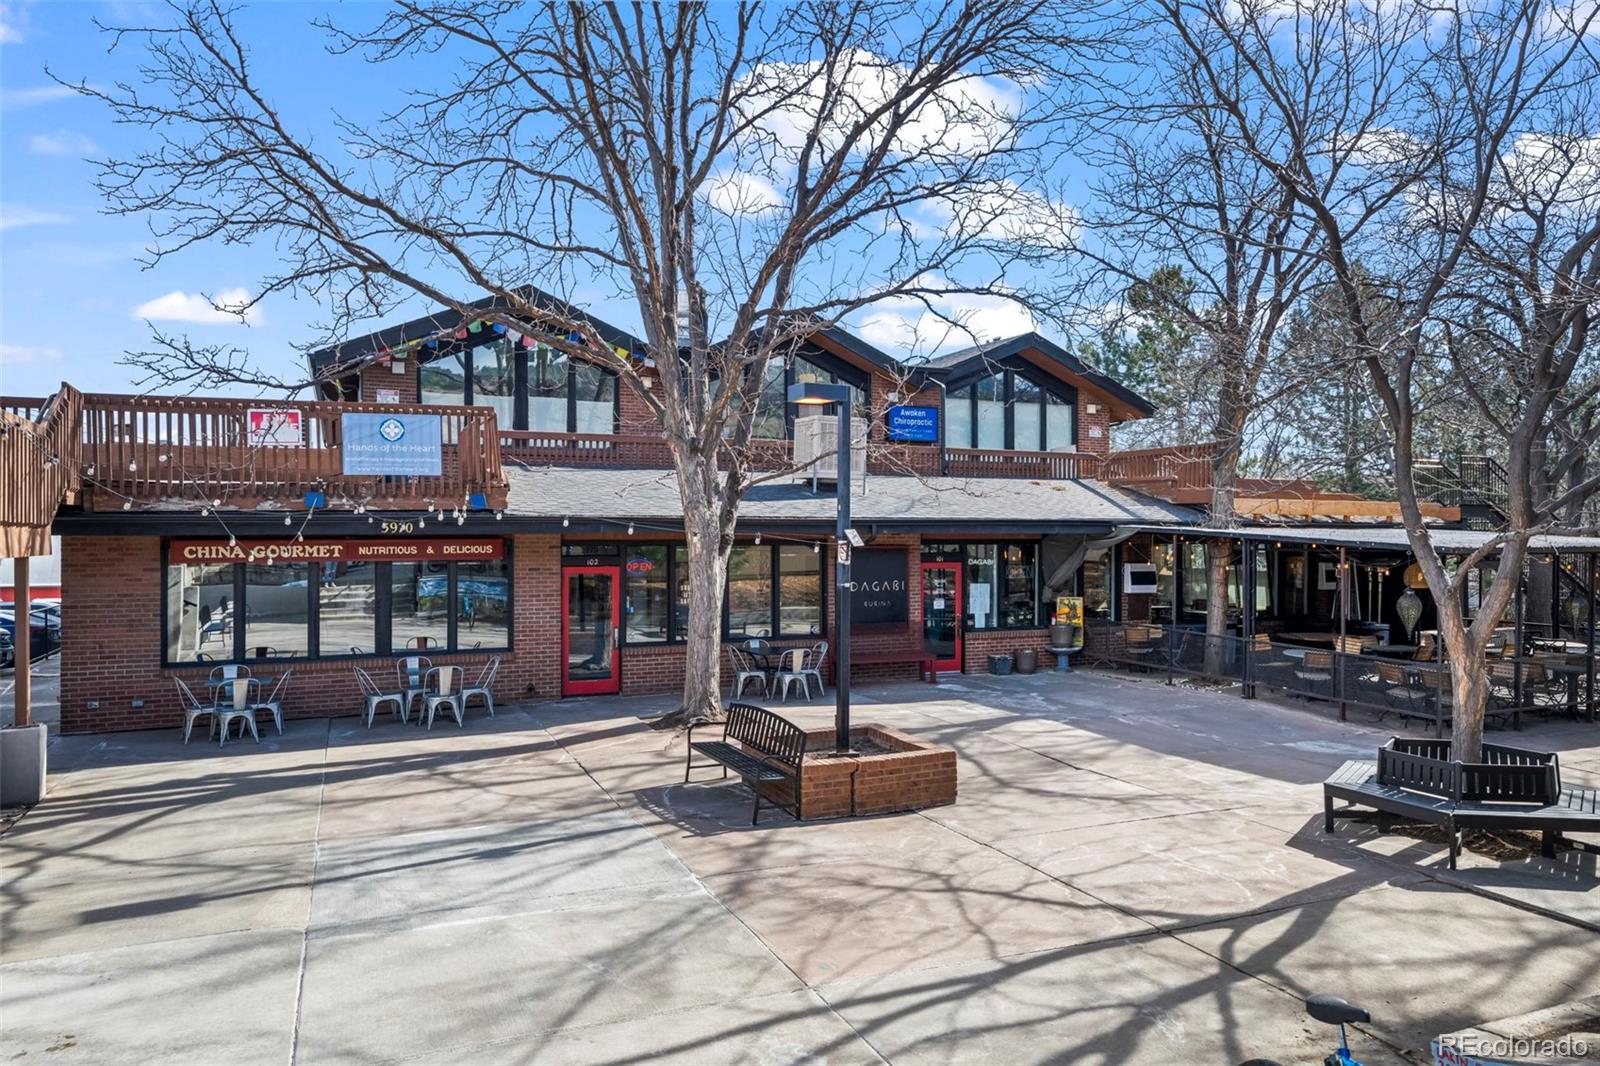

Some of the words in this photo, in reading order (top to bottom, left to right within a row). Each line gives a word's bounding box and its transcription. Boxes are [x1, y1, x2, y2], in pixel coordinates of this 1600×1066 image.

[901, 409, 926, 417] Awaken
[893, 417, 933, 426] Chiropractic
[347, 444, 378, 452] Hands
[380, 444, 390, 453] of
[392, 444, 407, 452] the
[409, 445, 436, 453] Heart
[183, 545, 246, 559] CHINA
[252, 544, 343, 558] GOURMET
[358, 545, 418, 555] NUTRITIOUS
[426, 545, 434, 554] &
[443, 545, 493, 554] DELICIOUS
[626, 563, 652, 572] OPEN
[850, 580, 905, 592] DAGABI
